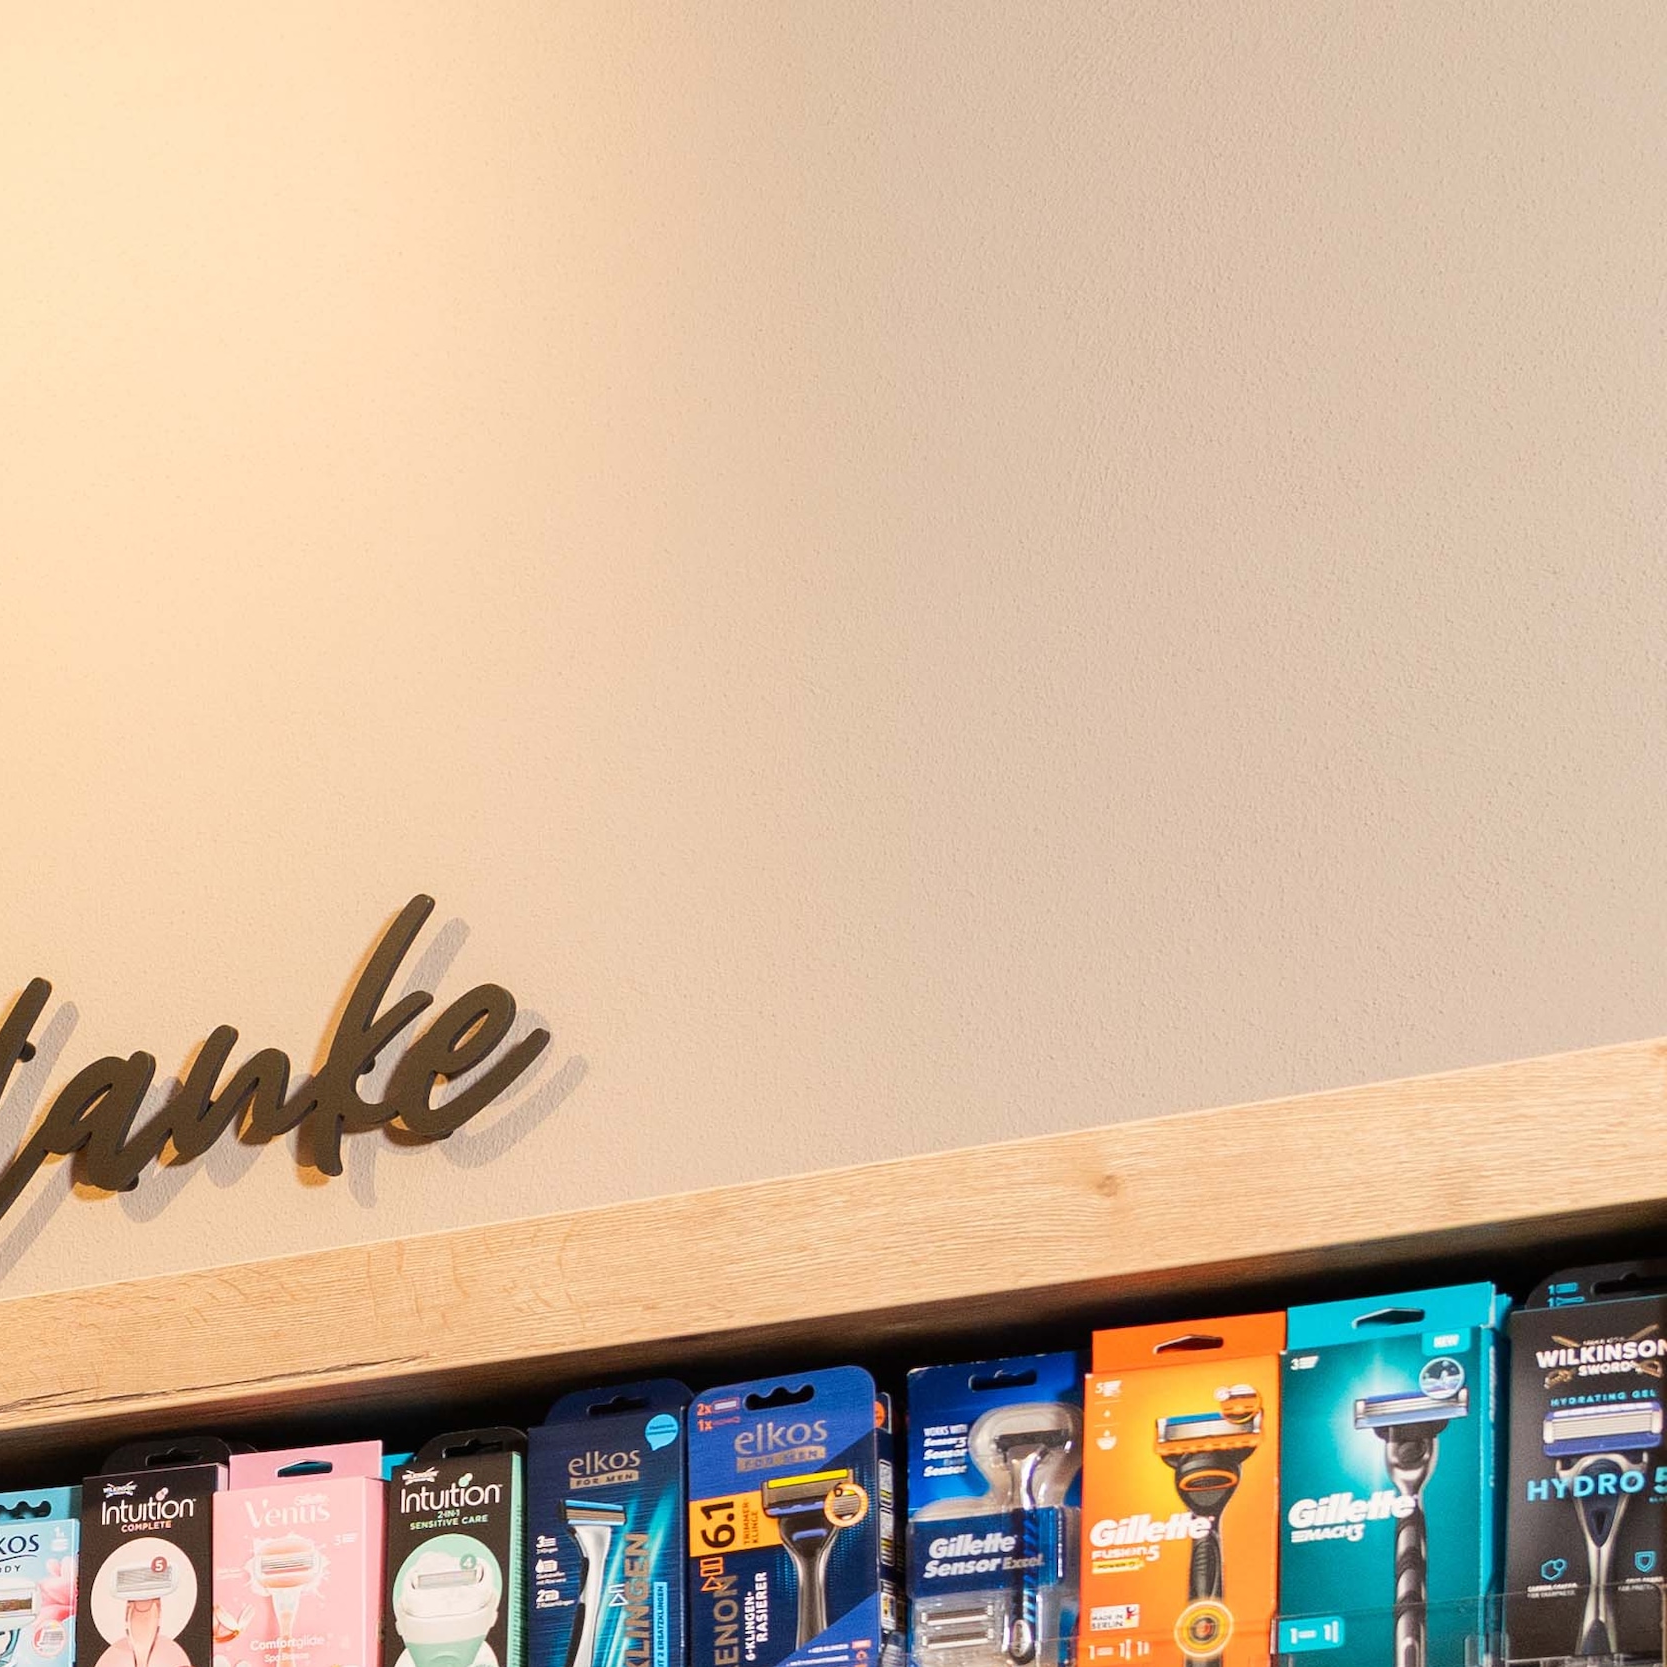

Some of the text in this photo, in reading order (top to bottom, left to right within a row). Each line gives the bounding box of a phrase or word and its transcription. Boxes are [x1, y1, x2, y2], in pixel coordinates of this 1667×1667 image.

[734, 1420, 828, 1454] elkos
[569, 1446, 641, 1478] elkos
[401, 1480, 503, 1513] Intuition
[1527, 1472, 1645, 1503] HYDRO
[102, 1492, 196, 1525] Intuition
[1289, 1493, 1419, 1530] Gillette
[121, 1520, 172, 1532] COMPLETE
[1090, 1515, 1214, 1549] Gillette
[928, 1532, 1015, 1559] Gillette
[924, 1552, 999, 1576] Sensor
